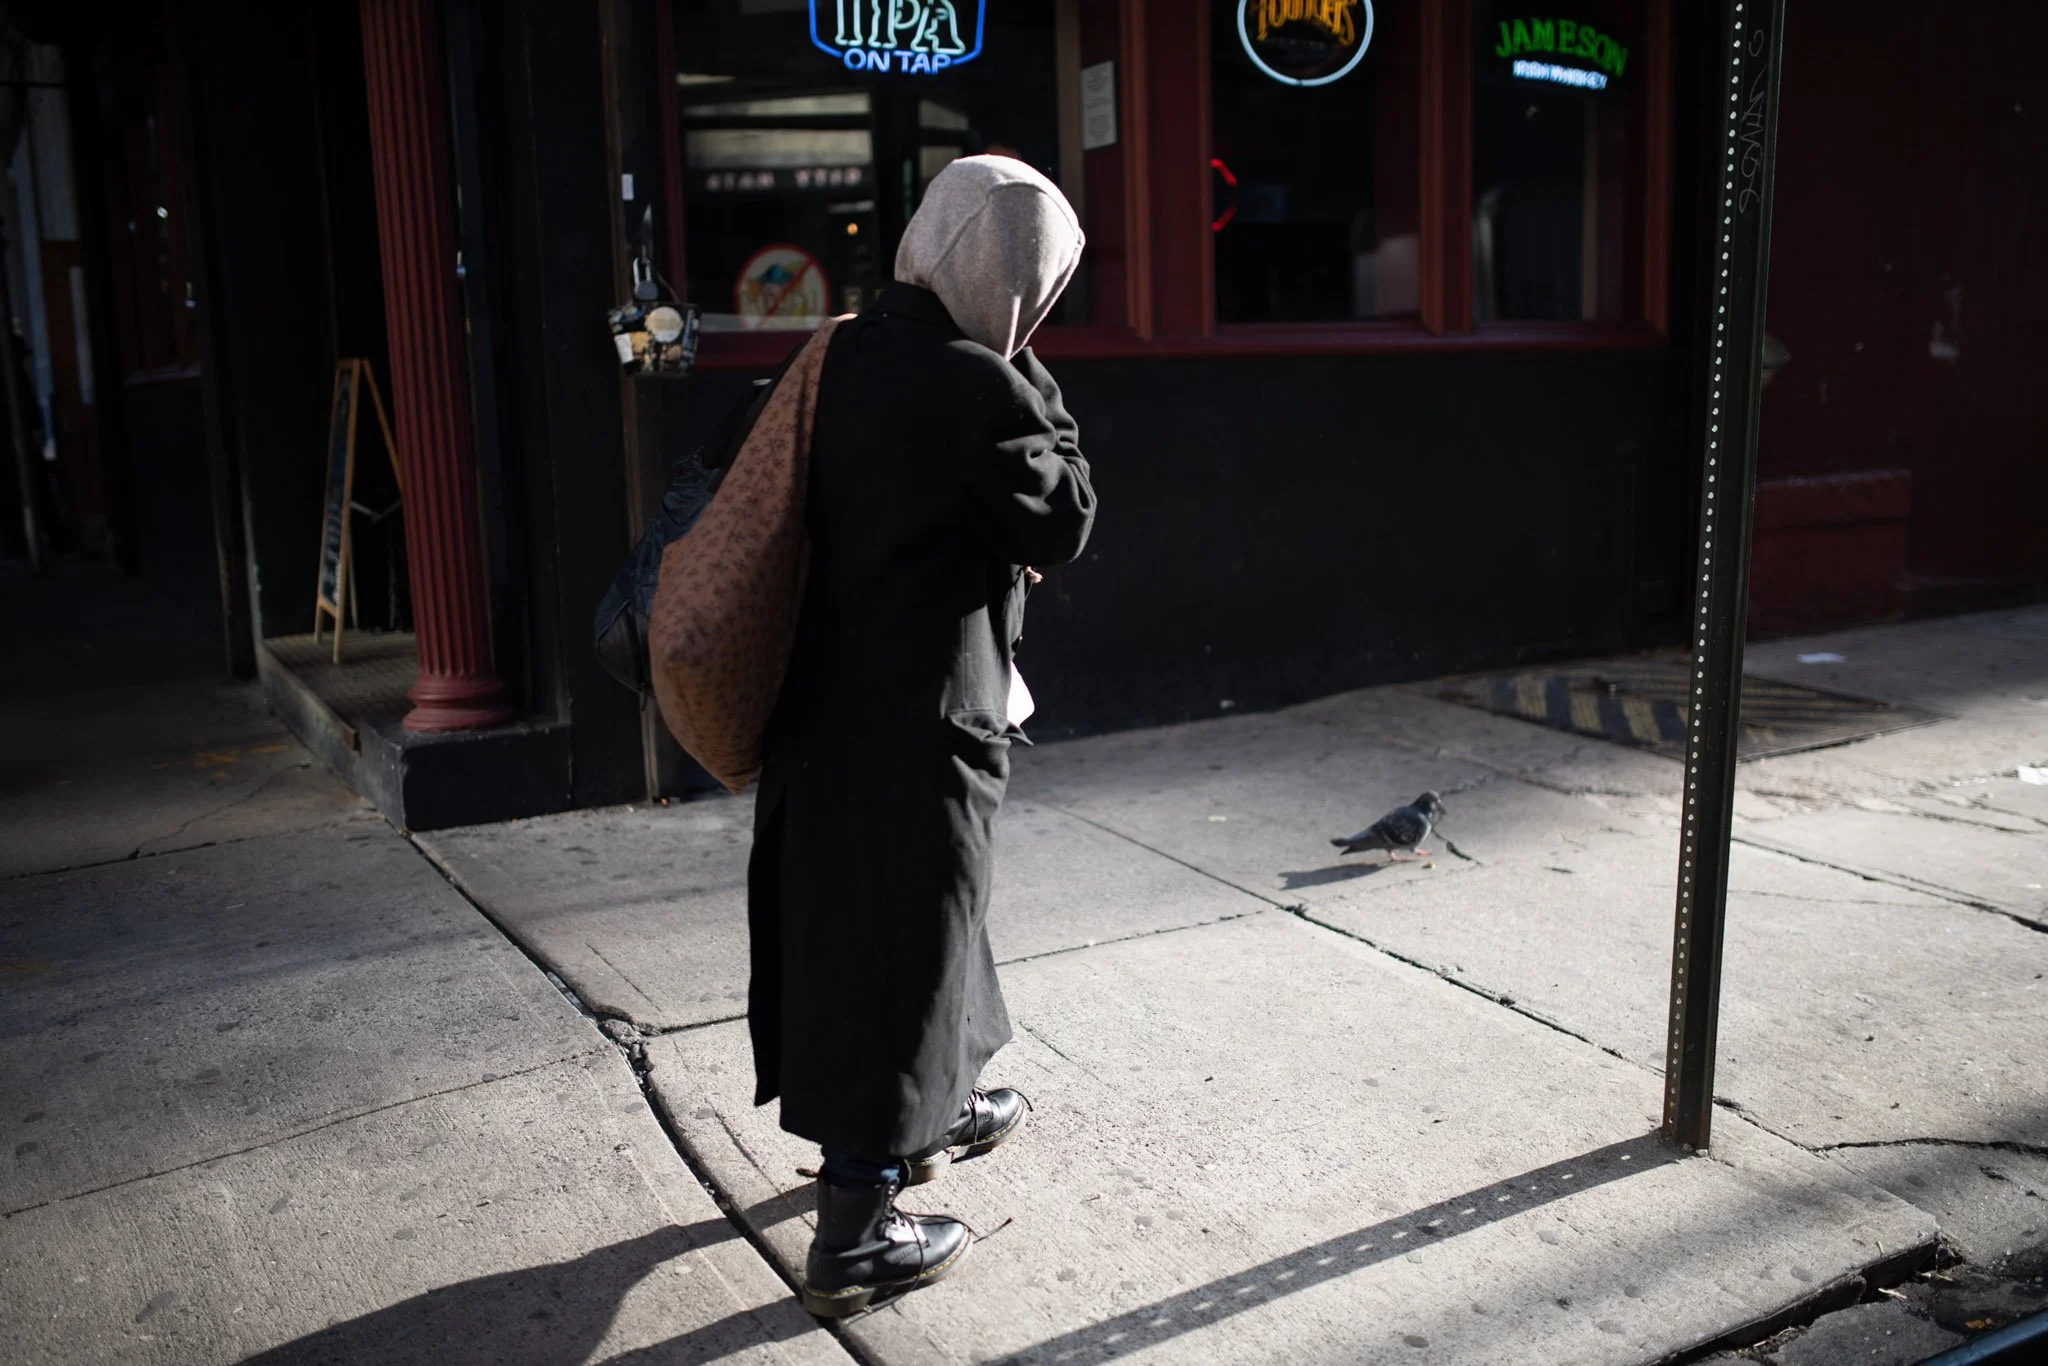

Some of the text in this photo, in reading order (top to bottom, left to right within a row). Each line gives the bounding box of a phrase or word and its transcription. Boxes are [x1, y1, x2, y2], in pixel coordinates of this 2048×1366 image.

[835, 0, 966, 55] IPA
[1495, 18, 1629, 77] JAMESON
[843, 48, 952, 75] ON TAP
